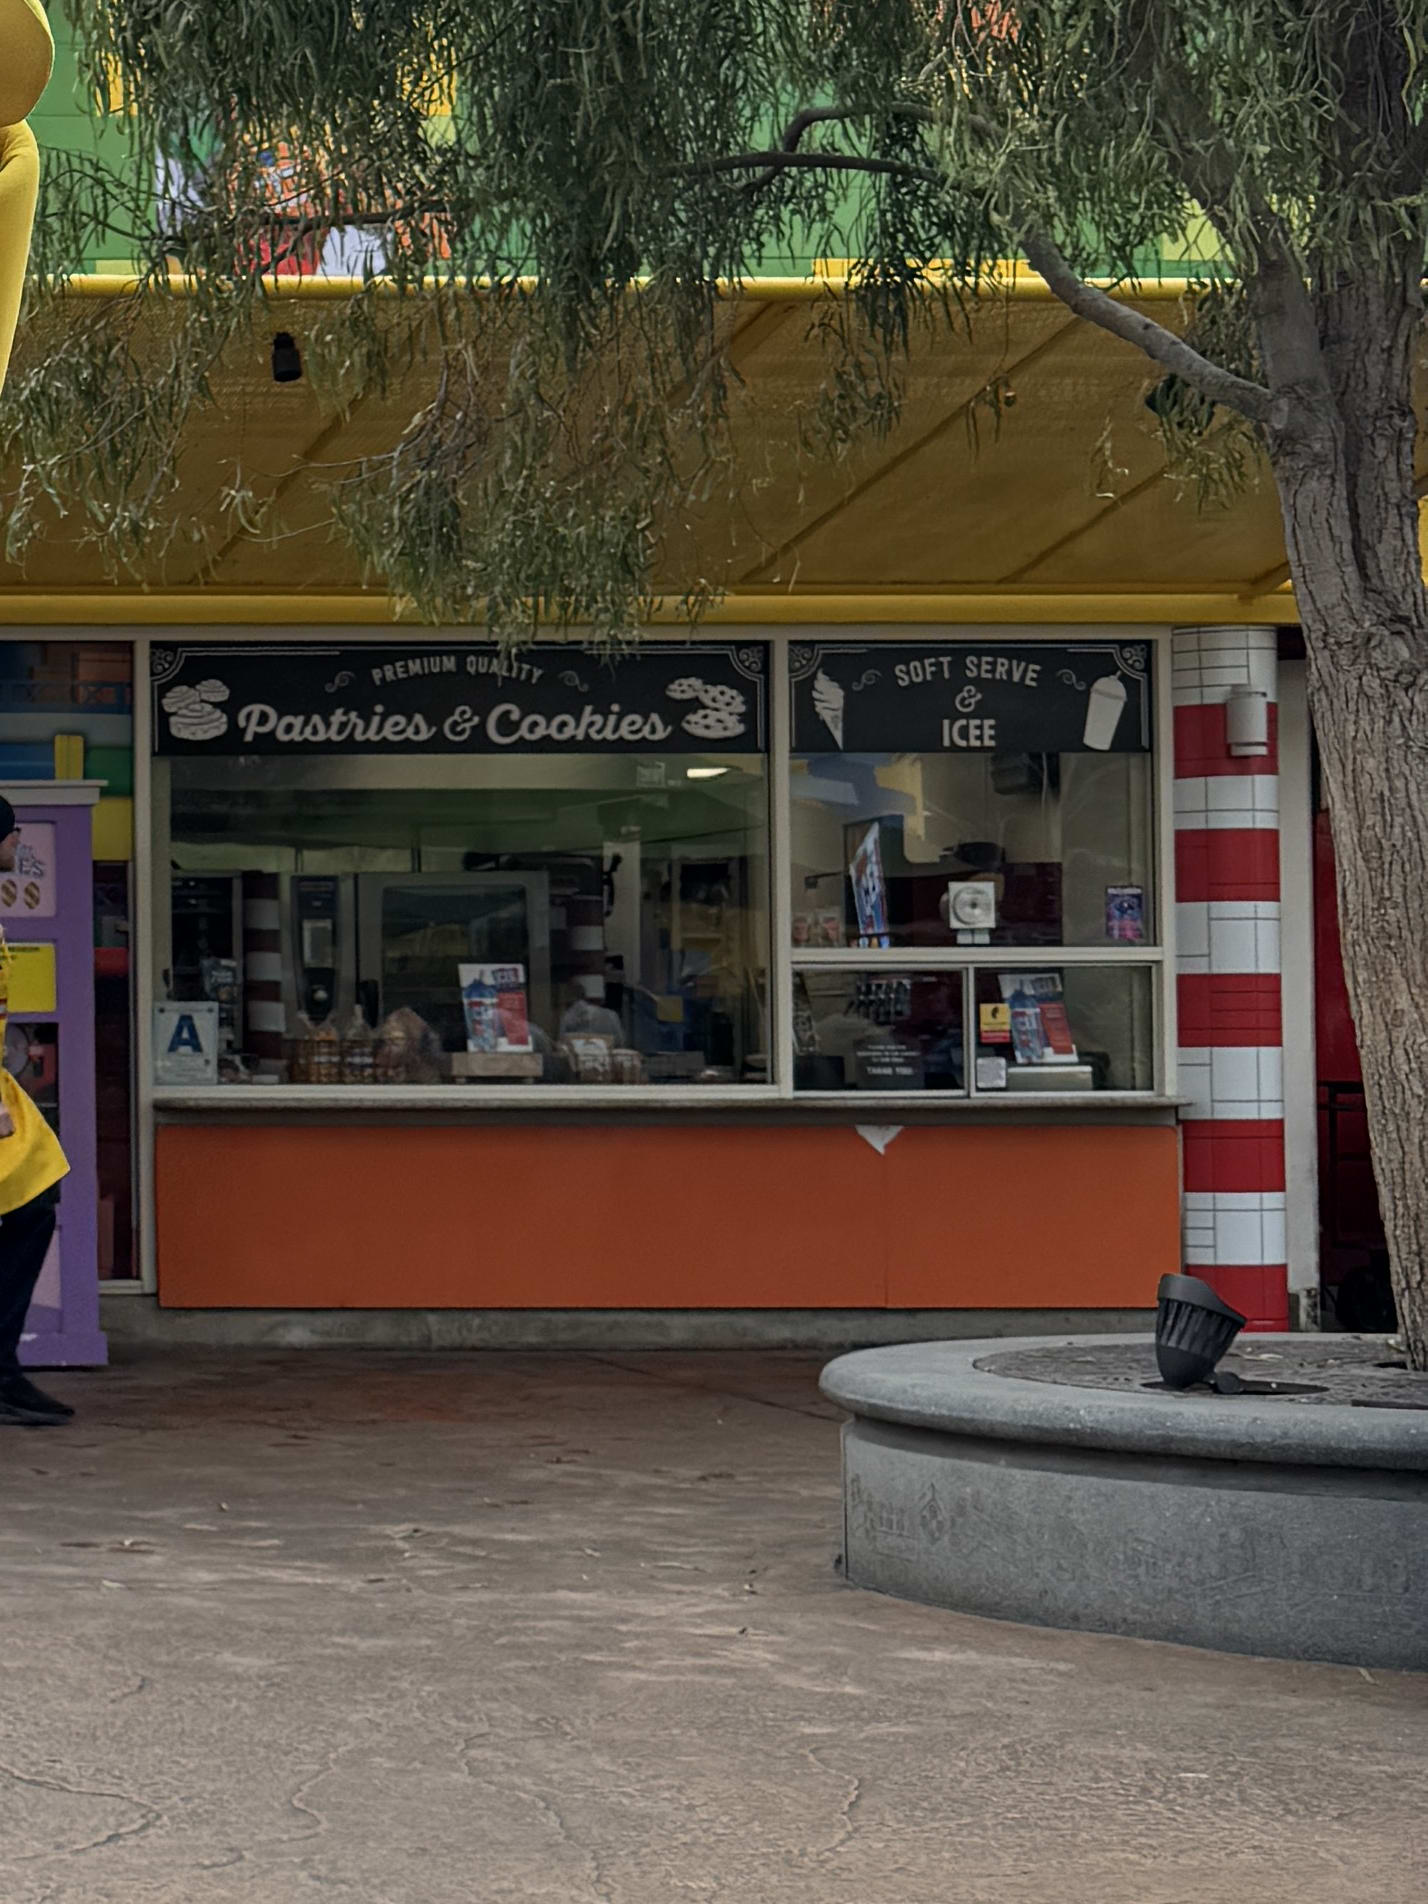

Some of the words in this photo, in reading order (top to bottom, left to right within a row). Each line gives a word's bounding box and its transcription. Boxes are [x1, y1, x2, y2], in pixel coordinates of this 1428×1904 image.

[371, 655, 457, 687] PREMIUM
[466, 655, 544, 685] QUALITY
[894, 656, 952, 687] SOFT
[965, 655, 1042, 687] SERVE
[955, 685, 982, 713] &
[237, 702, 437, 743] Pastries
[443, 705, 480, 742] &
[485, 702, 673, 745] Cookies
[942, 719, 996, 747] ICEE
[167, 1014, 203, 1053] A
